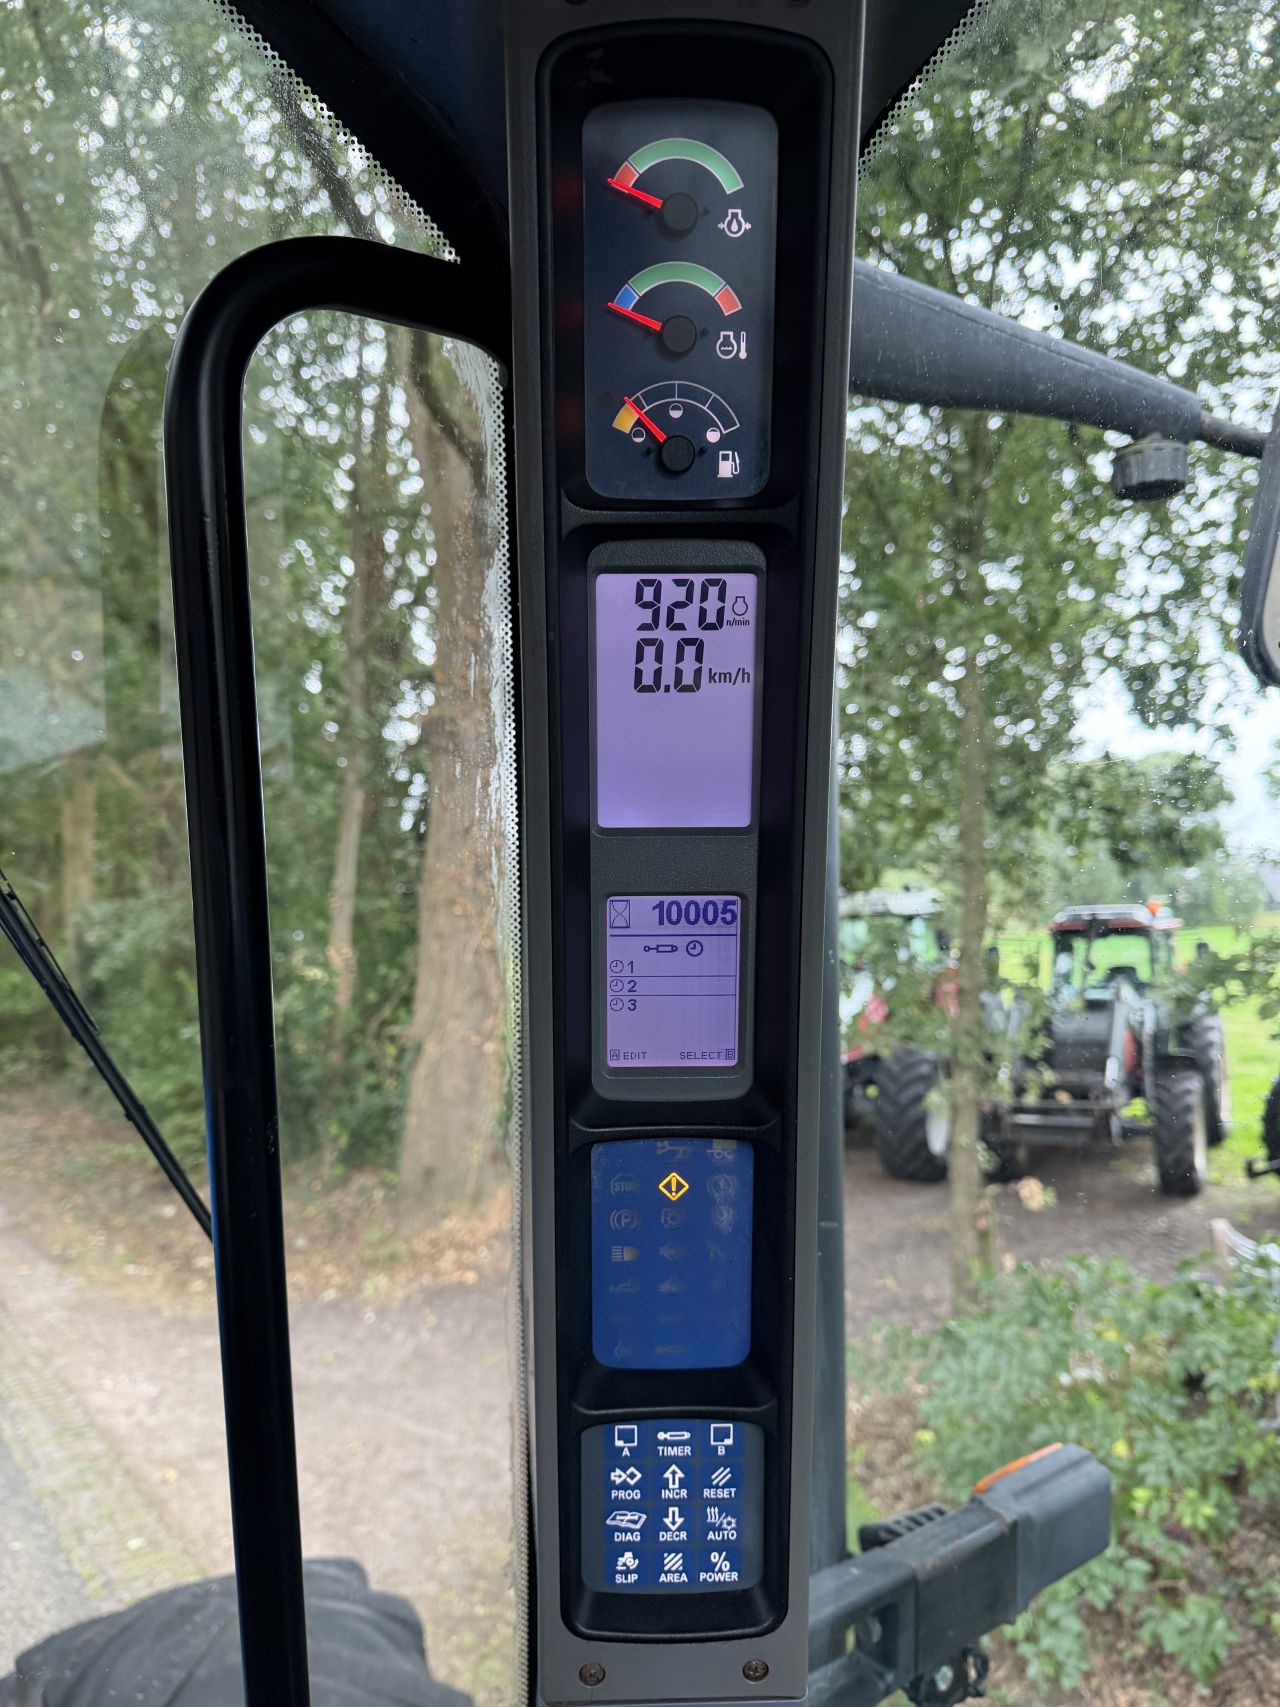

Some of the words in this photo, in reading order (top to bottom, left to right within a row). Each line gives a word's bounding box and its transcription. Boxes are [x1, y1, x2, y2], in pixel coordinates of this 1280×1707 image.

[635, 578, 727, 631] 920
[726, 618, 750, 627] n/min
[633, 638, 705, 693] 0.0
[708, 667, 751, 685] km/h
[651, 900, 737, 926] 10005
[627, 960, 634, 974] 1
[627, 979, 637, 993] 2
[627, 998, 637, 1012] 3
[623, 1051, 648, 1060] EDIT
[679, 1051, 722, 1060] SELECT
[621, 1214, 632, 1227] P
[621, 1447, 631, 1457] A
[657, 1446, 692, 1456] TIMER
[717, 1446, 726, 1456] B
[611, 1489, 641, 1500] PROG
[661, 1489, 688, 1499] INCR
[703, 1488, 737, 1498] RESET
[614, 1531, 641, 1542] DIAG
[659, 1531, 688, 1541] DECR
[706, 1530, 737, 1541] AUTO
[615, 1573, 639, 1584] SLIP
[659, 1572, 688, 1583] AREA
[699, 1572, 739, 1582] POWER
